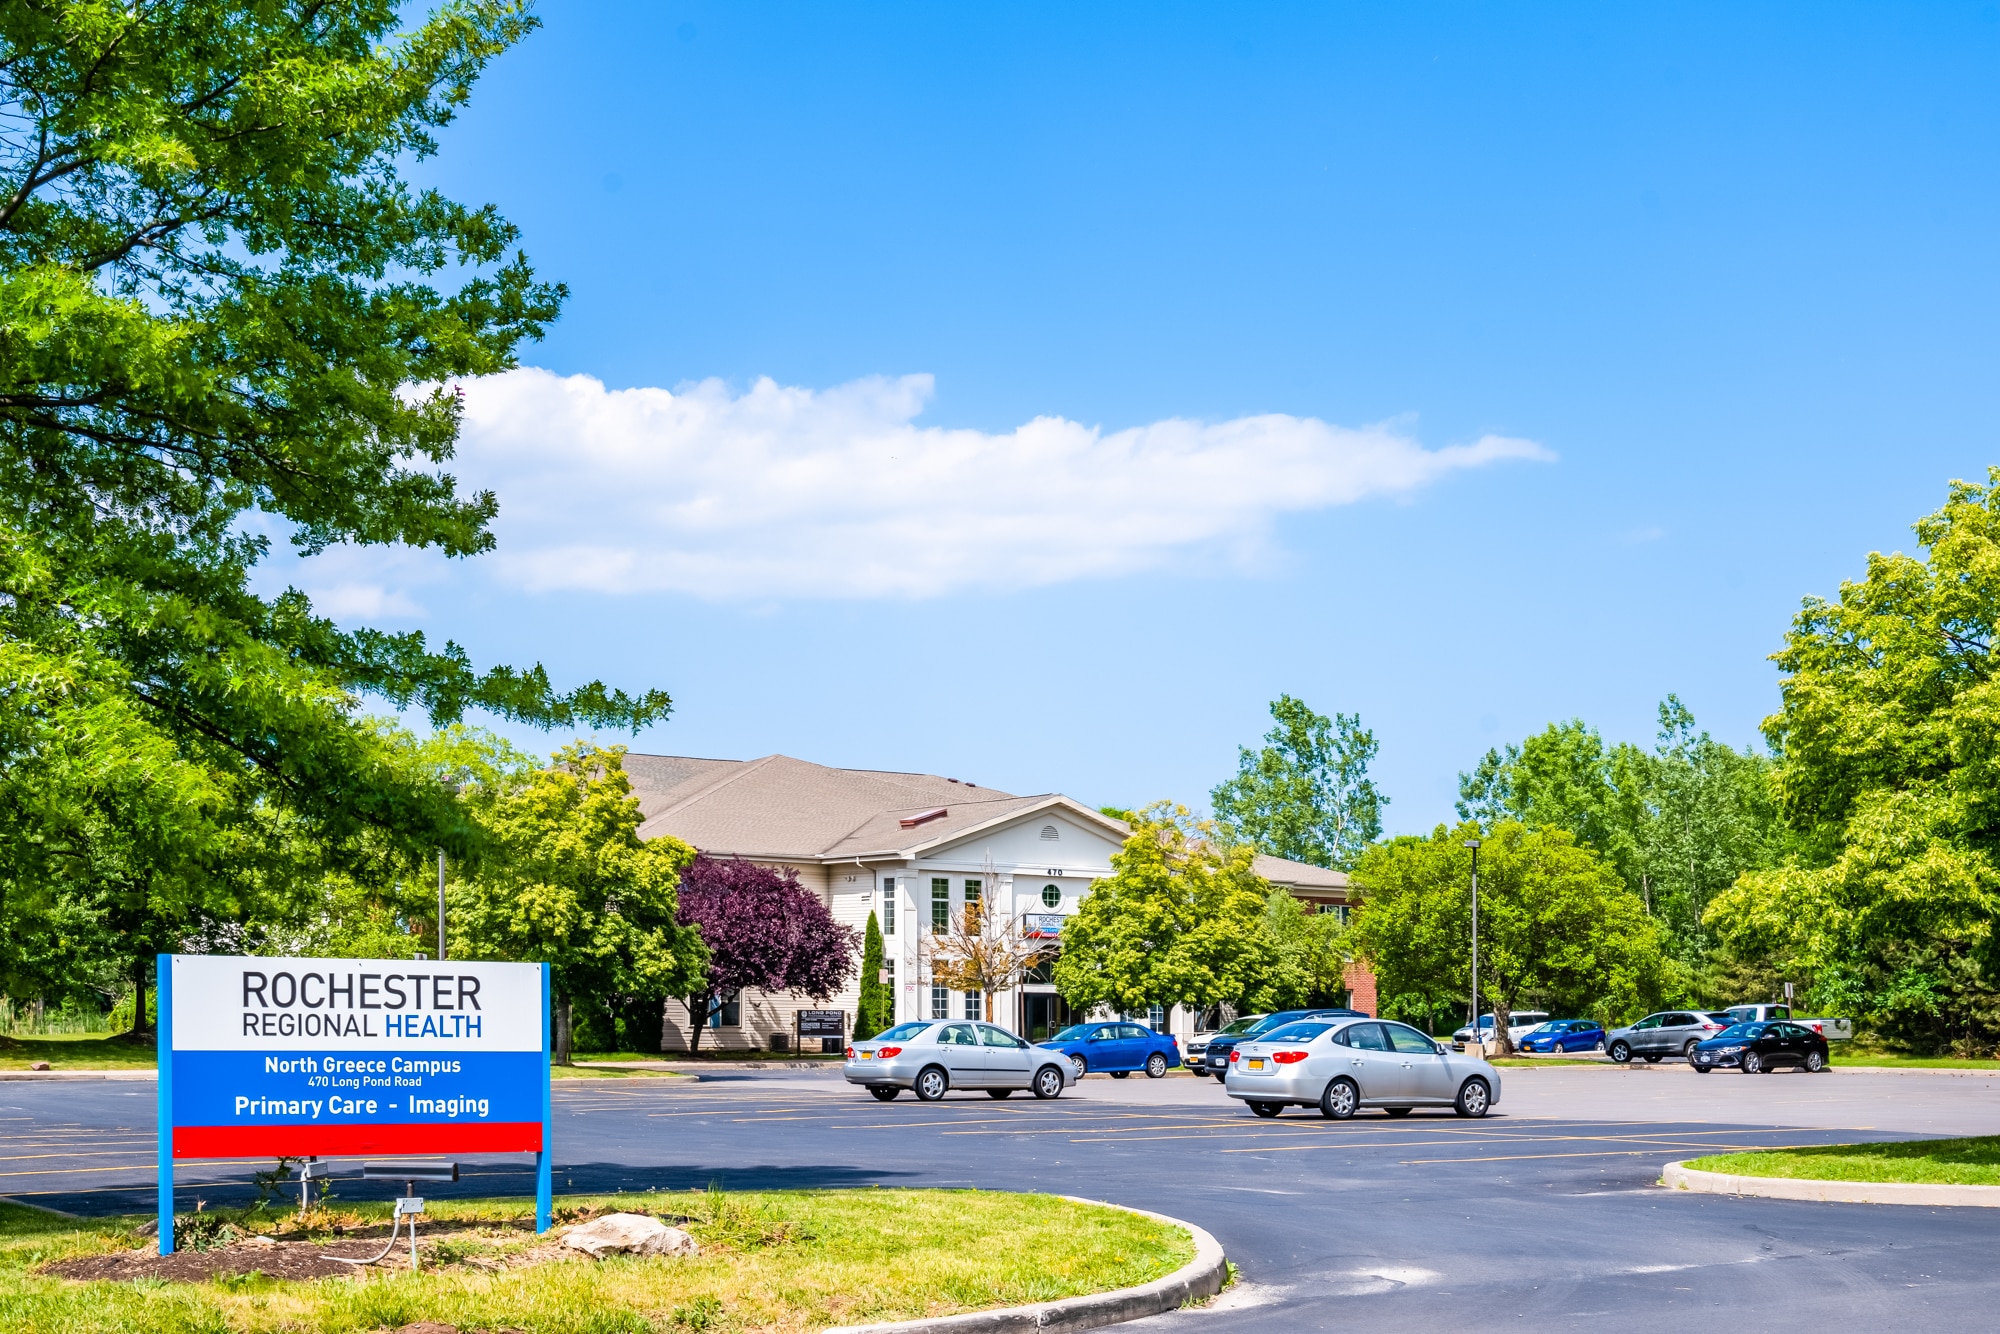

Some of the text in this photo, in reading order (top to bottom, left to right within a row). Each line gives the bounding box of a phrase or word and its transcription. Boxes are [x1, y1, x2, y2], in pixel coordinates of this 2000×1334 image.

[1047, 868, 1063, 876] 470
[243, 971, 482, 1011] ROCHESTER
[243, 1012, 482, 1038] REGIONAL HEALTH
[265, 1056, 462, 1076] North Greece Campus
[308, 1075, 422, 1090] 470 Long Pond Road
[235, 1095, 323, 1119] Primary
[328, 1095, 378, 1115] Care
[409, 1094, 489, 1118] Imaging
